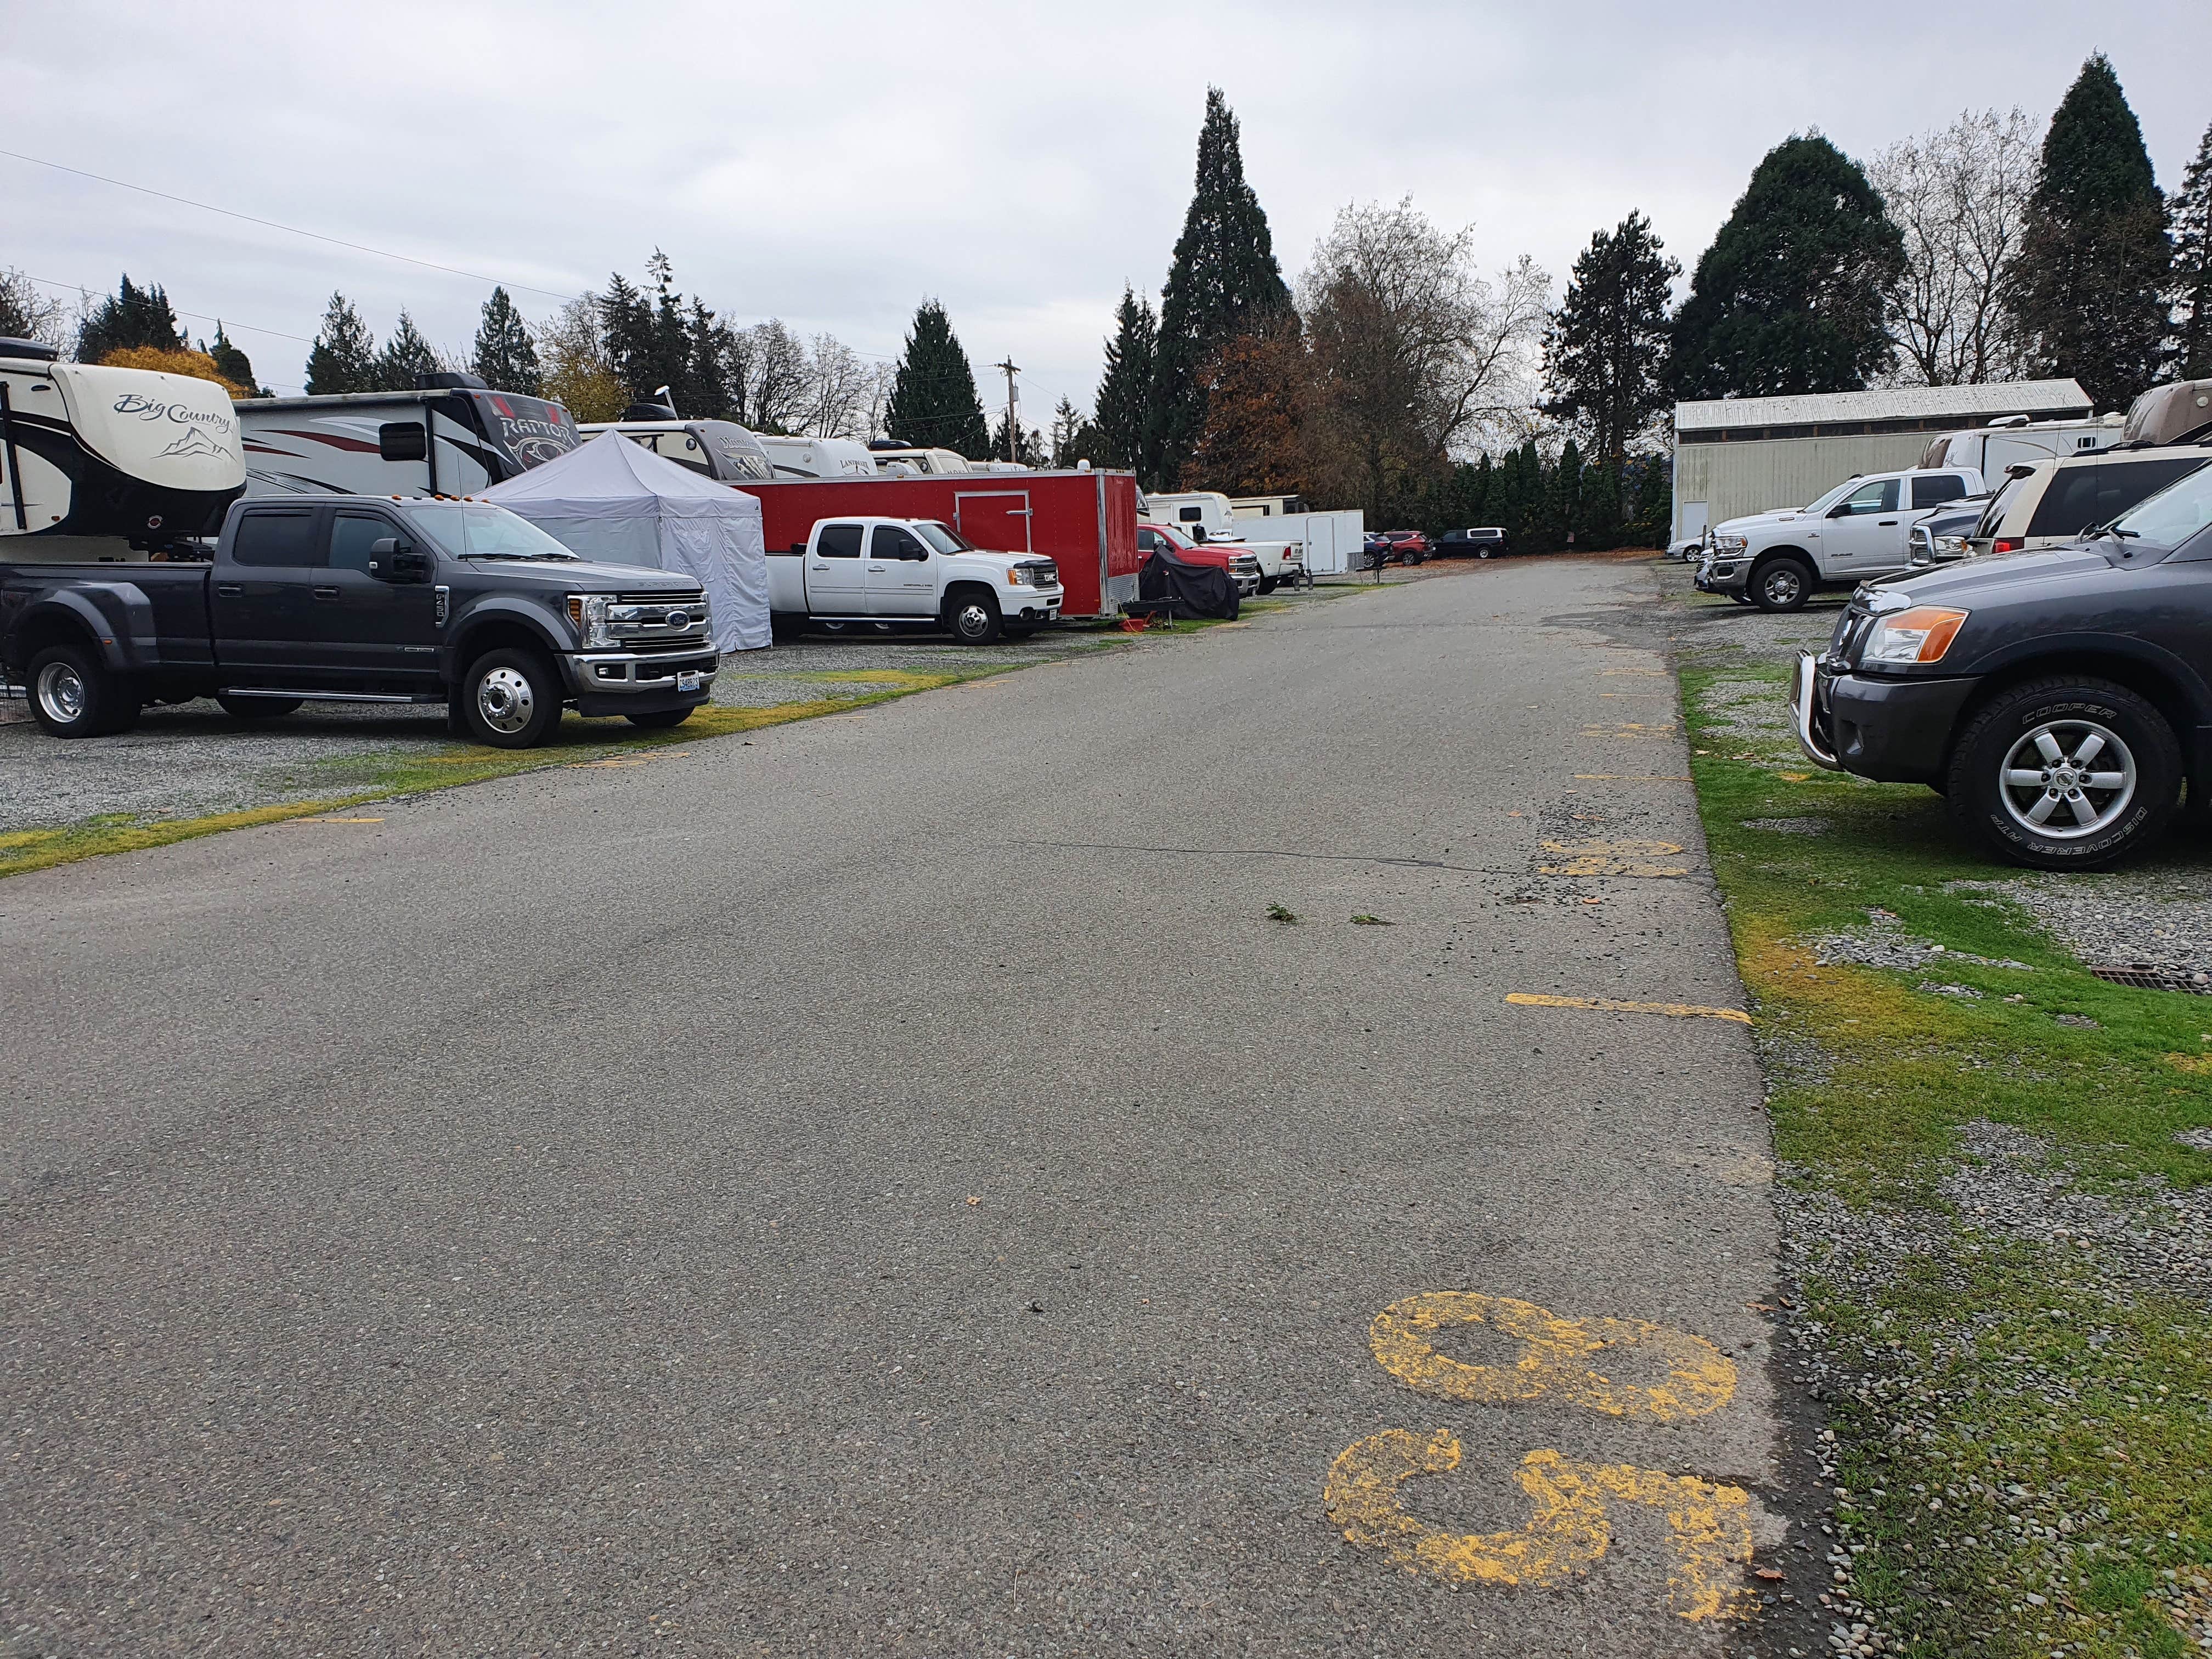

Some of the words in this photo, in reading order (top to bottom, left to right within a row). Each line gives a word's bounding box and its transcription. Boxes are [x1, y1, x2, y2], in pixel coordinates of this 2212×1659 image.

[114, 394, 166, 421] Big
[167, 404, 232, 434] Country
[500, 417, 576, 446] RAPTOR
[2022, 703, 2118, 724] COOPER
[1990, 814, 2023, 843] ATP
[2028, 806, 2148, 855] DISCOVERER
[1323, 1291, 1762, 1621] 85
